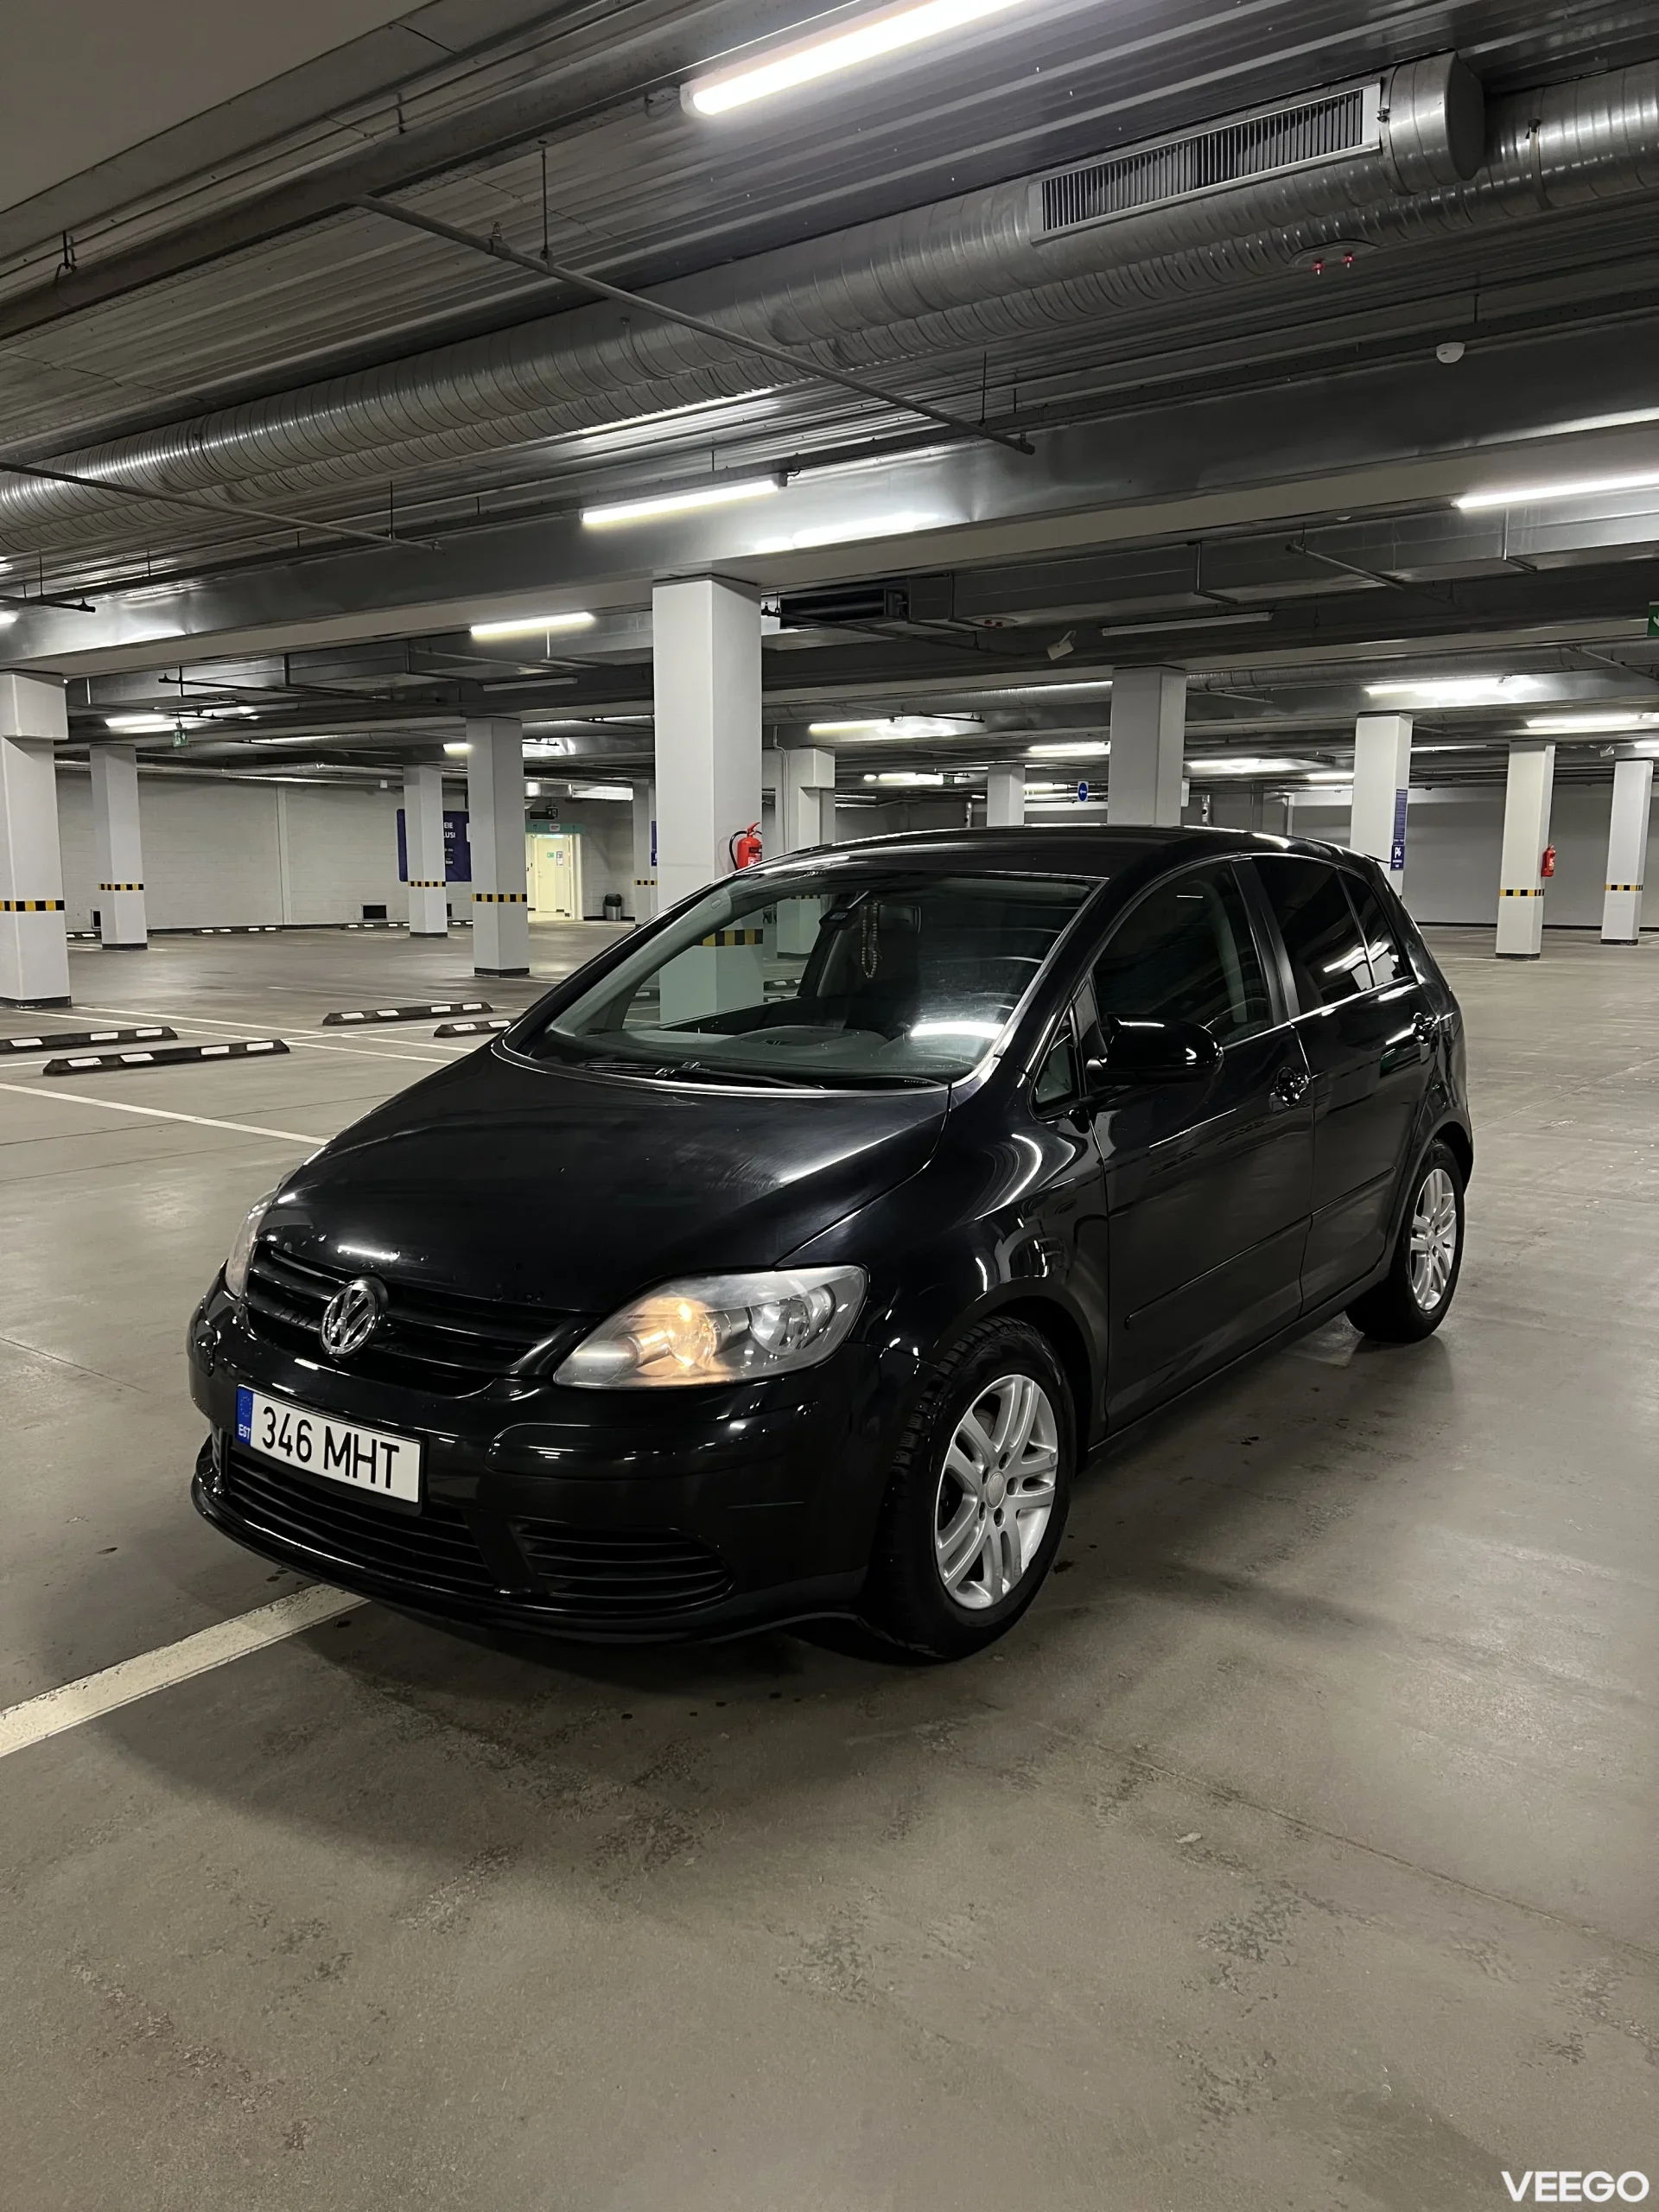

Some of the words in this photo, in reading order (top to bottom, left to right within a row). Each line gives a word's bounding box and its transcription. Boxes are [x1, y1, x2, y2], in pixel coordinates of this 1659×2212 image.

[238, 1424, 251, 1439] EST
[262, 1406, 313, 1463] 346
[324, 1426, 399, 1489] MHT
